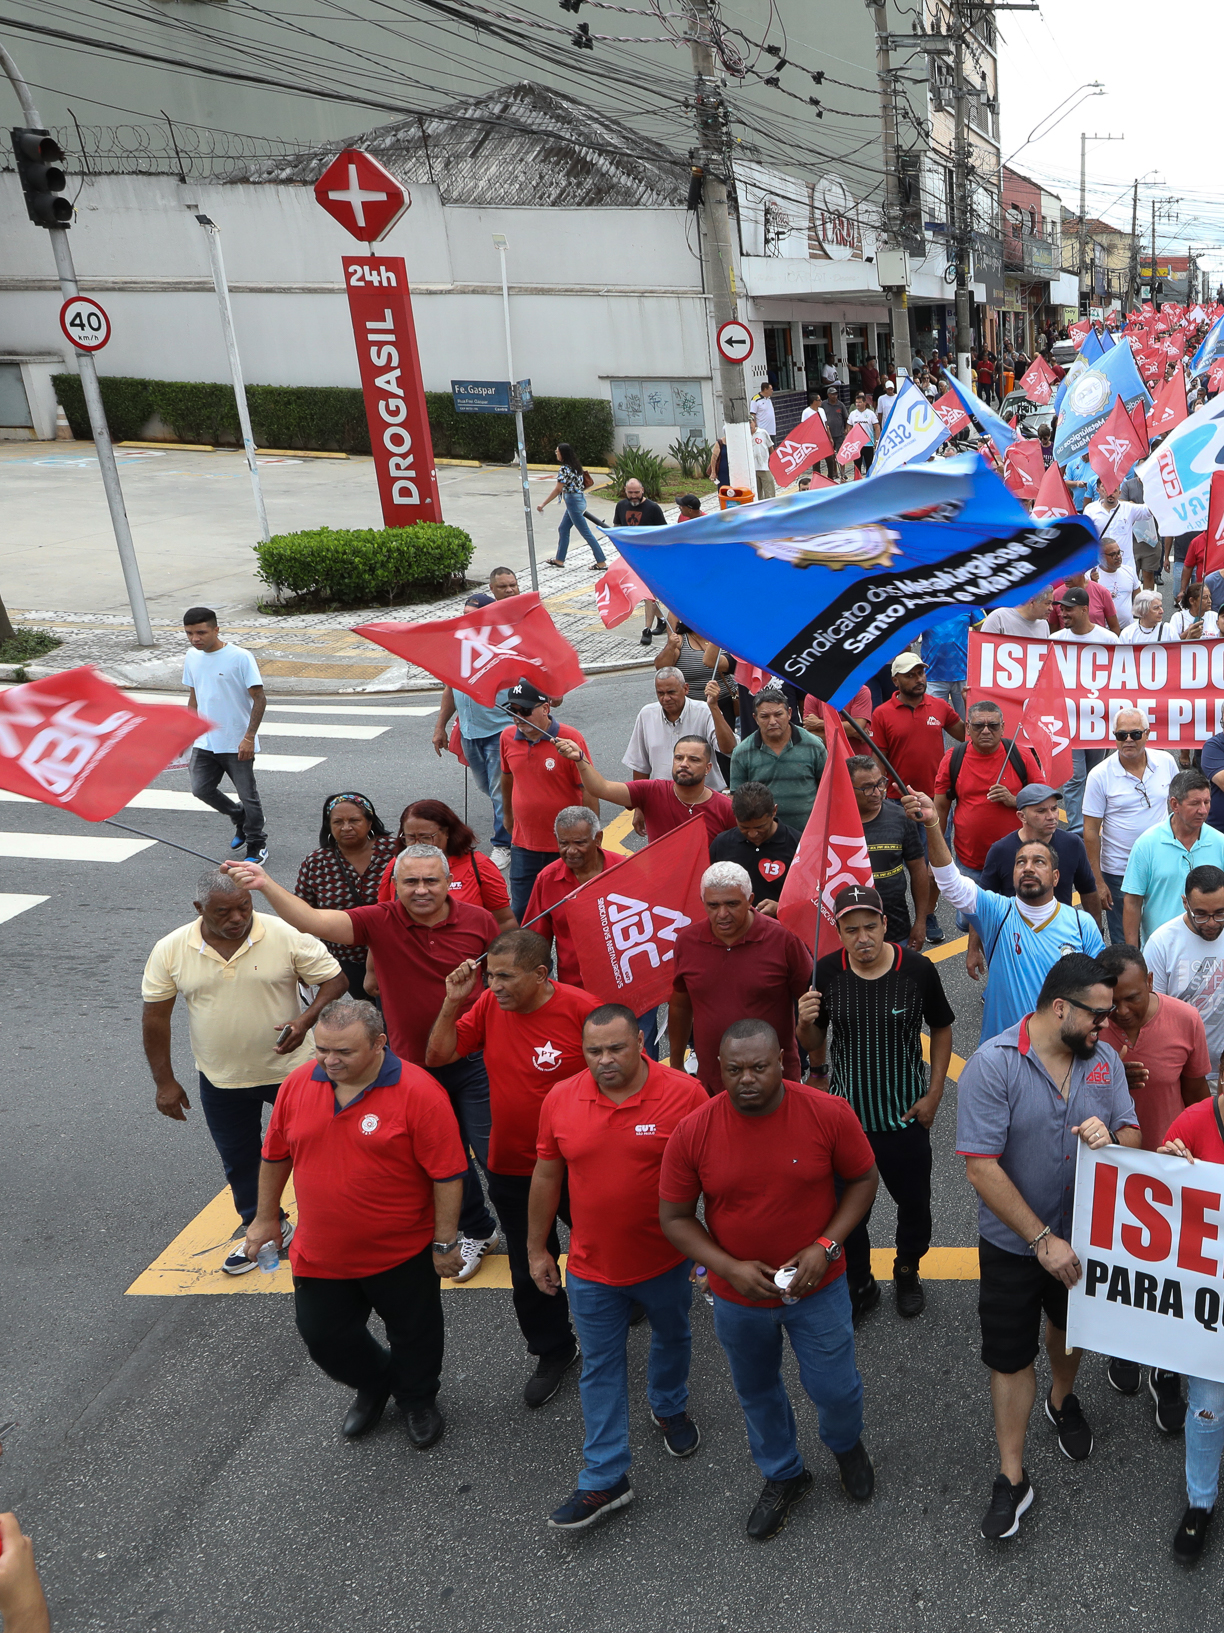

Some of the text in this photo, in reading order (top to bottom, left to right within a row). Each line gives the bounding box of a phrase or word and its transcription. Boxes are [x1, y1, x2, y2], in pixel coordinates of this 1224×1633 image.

[348, 264, 397, 287] 24h
[69, 311, 102, 332] 40
[454, 384, 496, 396] Fe. Gaspar
[365, 308, 420, 505] DROGASIL
[784, 600, 872, 677] Sindicato
[843, 602, 906, 655] Santo
[763, 862, 780, 875] 13
[597, 896, 609, 927] SINDICATO
[606, 892, 661, 985] ABC
[541, 1050, 555, 1059] PT
[1085, 1071, 1112, 1082] ABC
[1084, 1258, 1184, 1320] PARA
